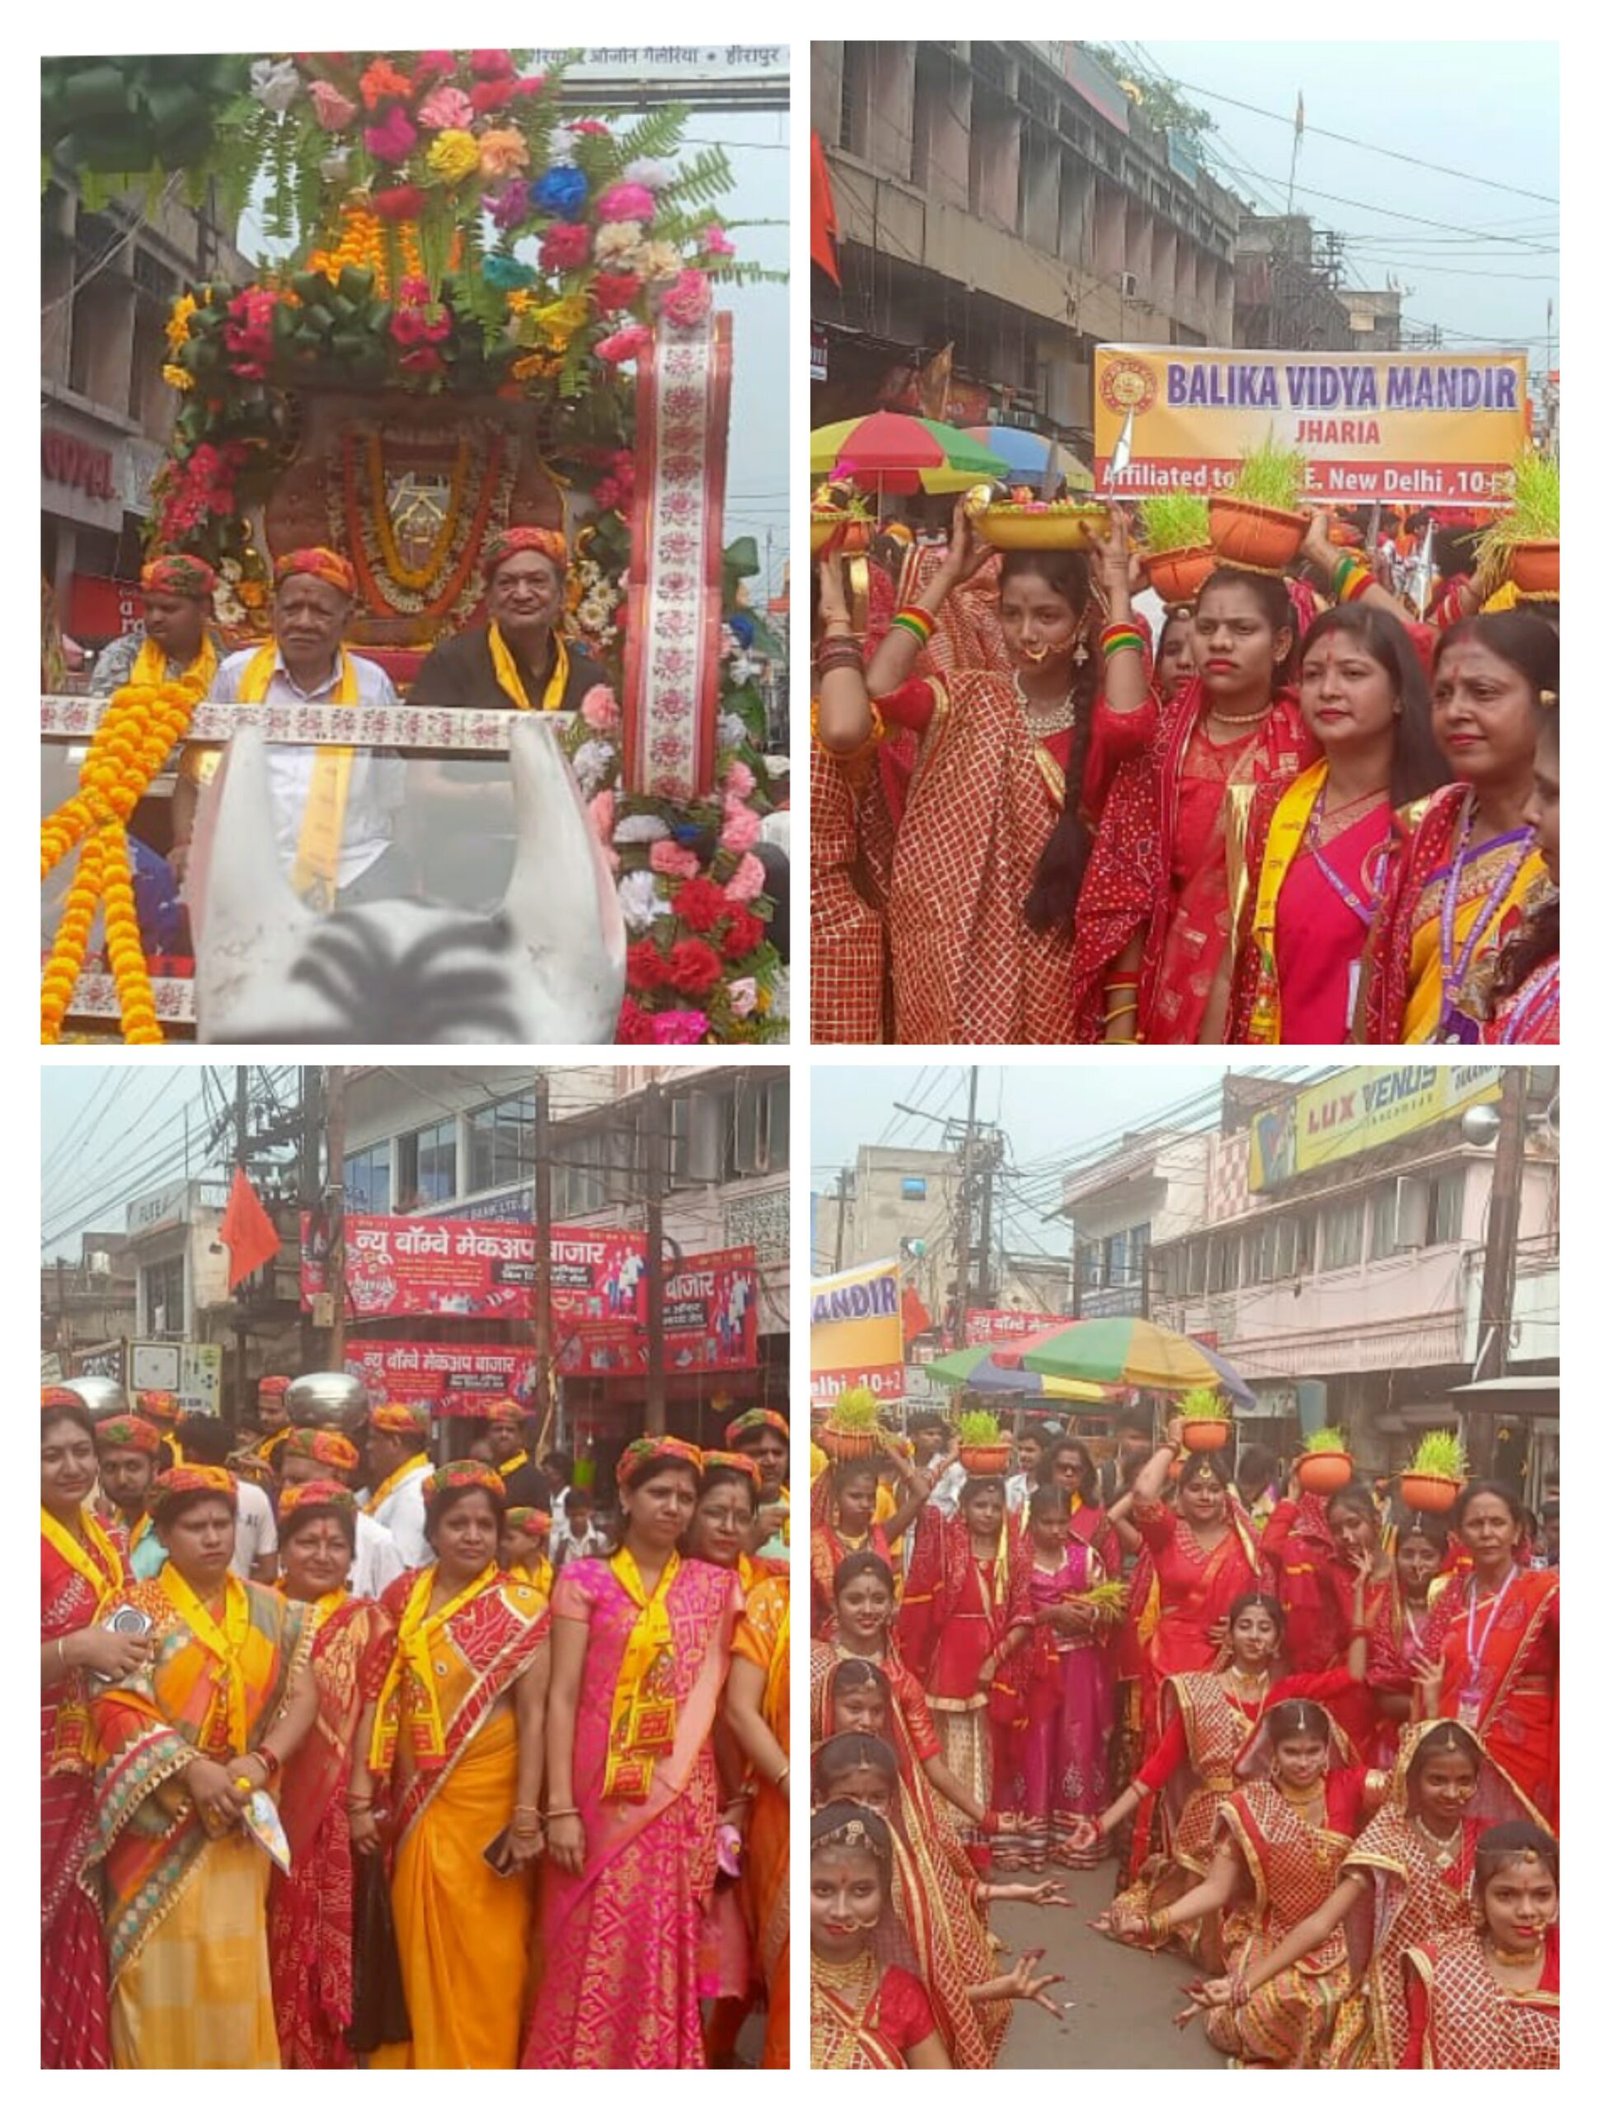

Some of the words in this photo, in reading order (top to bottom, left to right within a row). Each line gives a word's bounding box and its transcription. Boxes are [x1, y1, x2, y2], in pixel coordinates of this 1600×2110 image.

[1166, 363, 1279, 411] BALIKA
[1285, 365, 1377, 412] VIDYA
[1387, 366, 1520, 412] MANDIR
[1296, 419, 1381, 446] JHARIA
[1213, 467, 1235, 488] to
[1329, 468, 1377, 491] New
[1384, 469, 1442, 492] Delhi
[1307, 1089, 1357, 1135] LUX
[1362, 1065, 1437, 1112] VENUS
[811, 1276, 897, 1320] ANDIR
